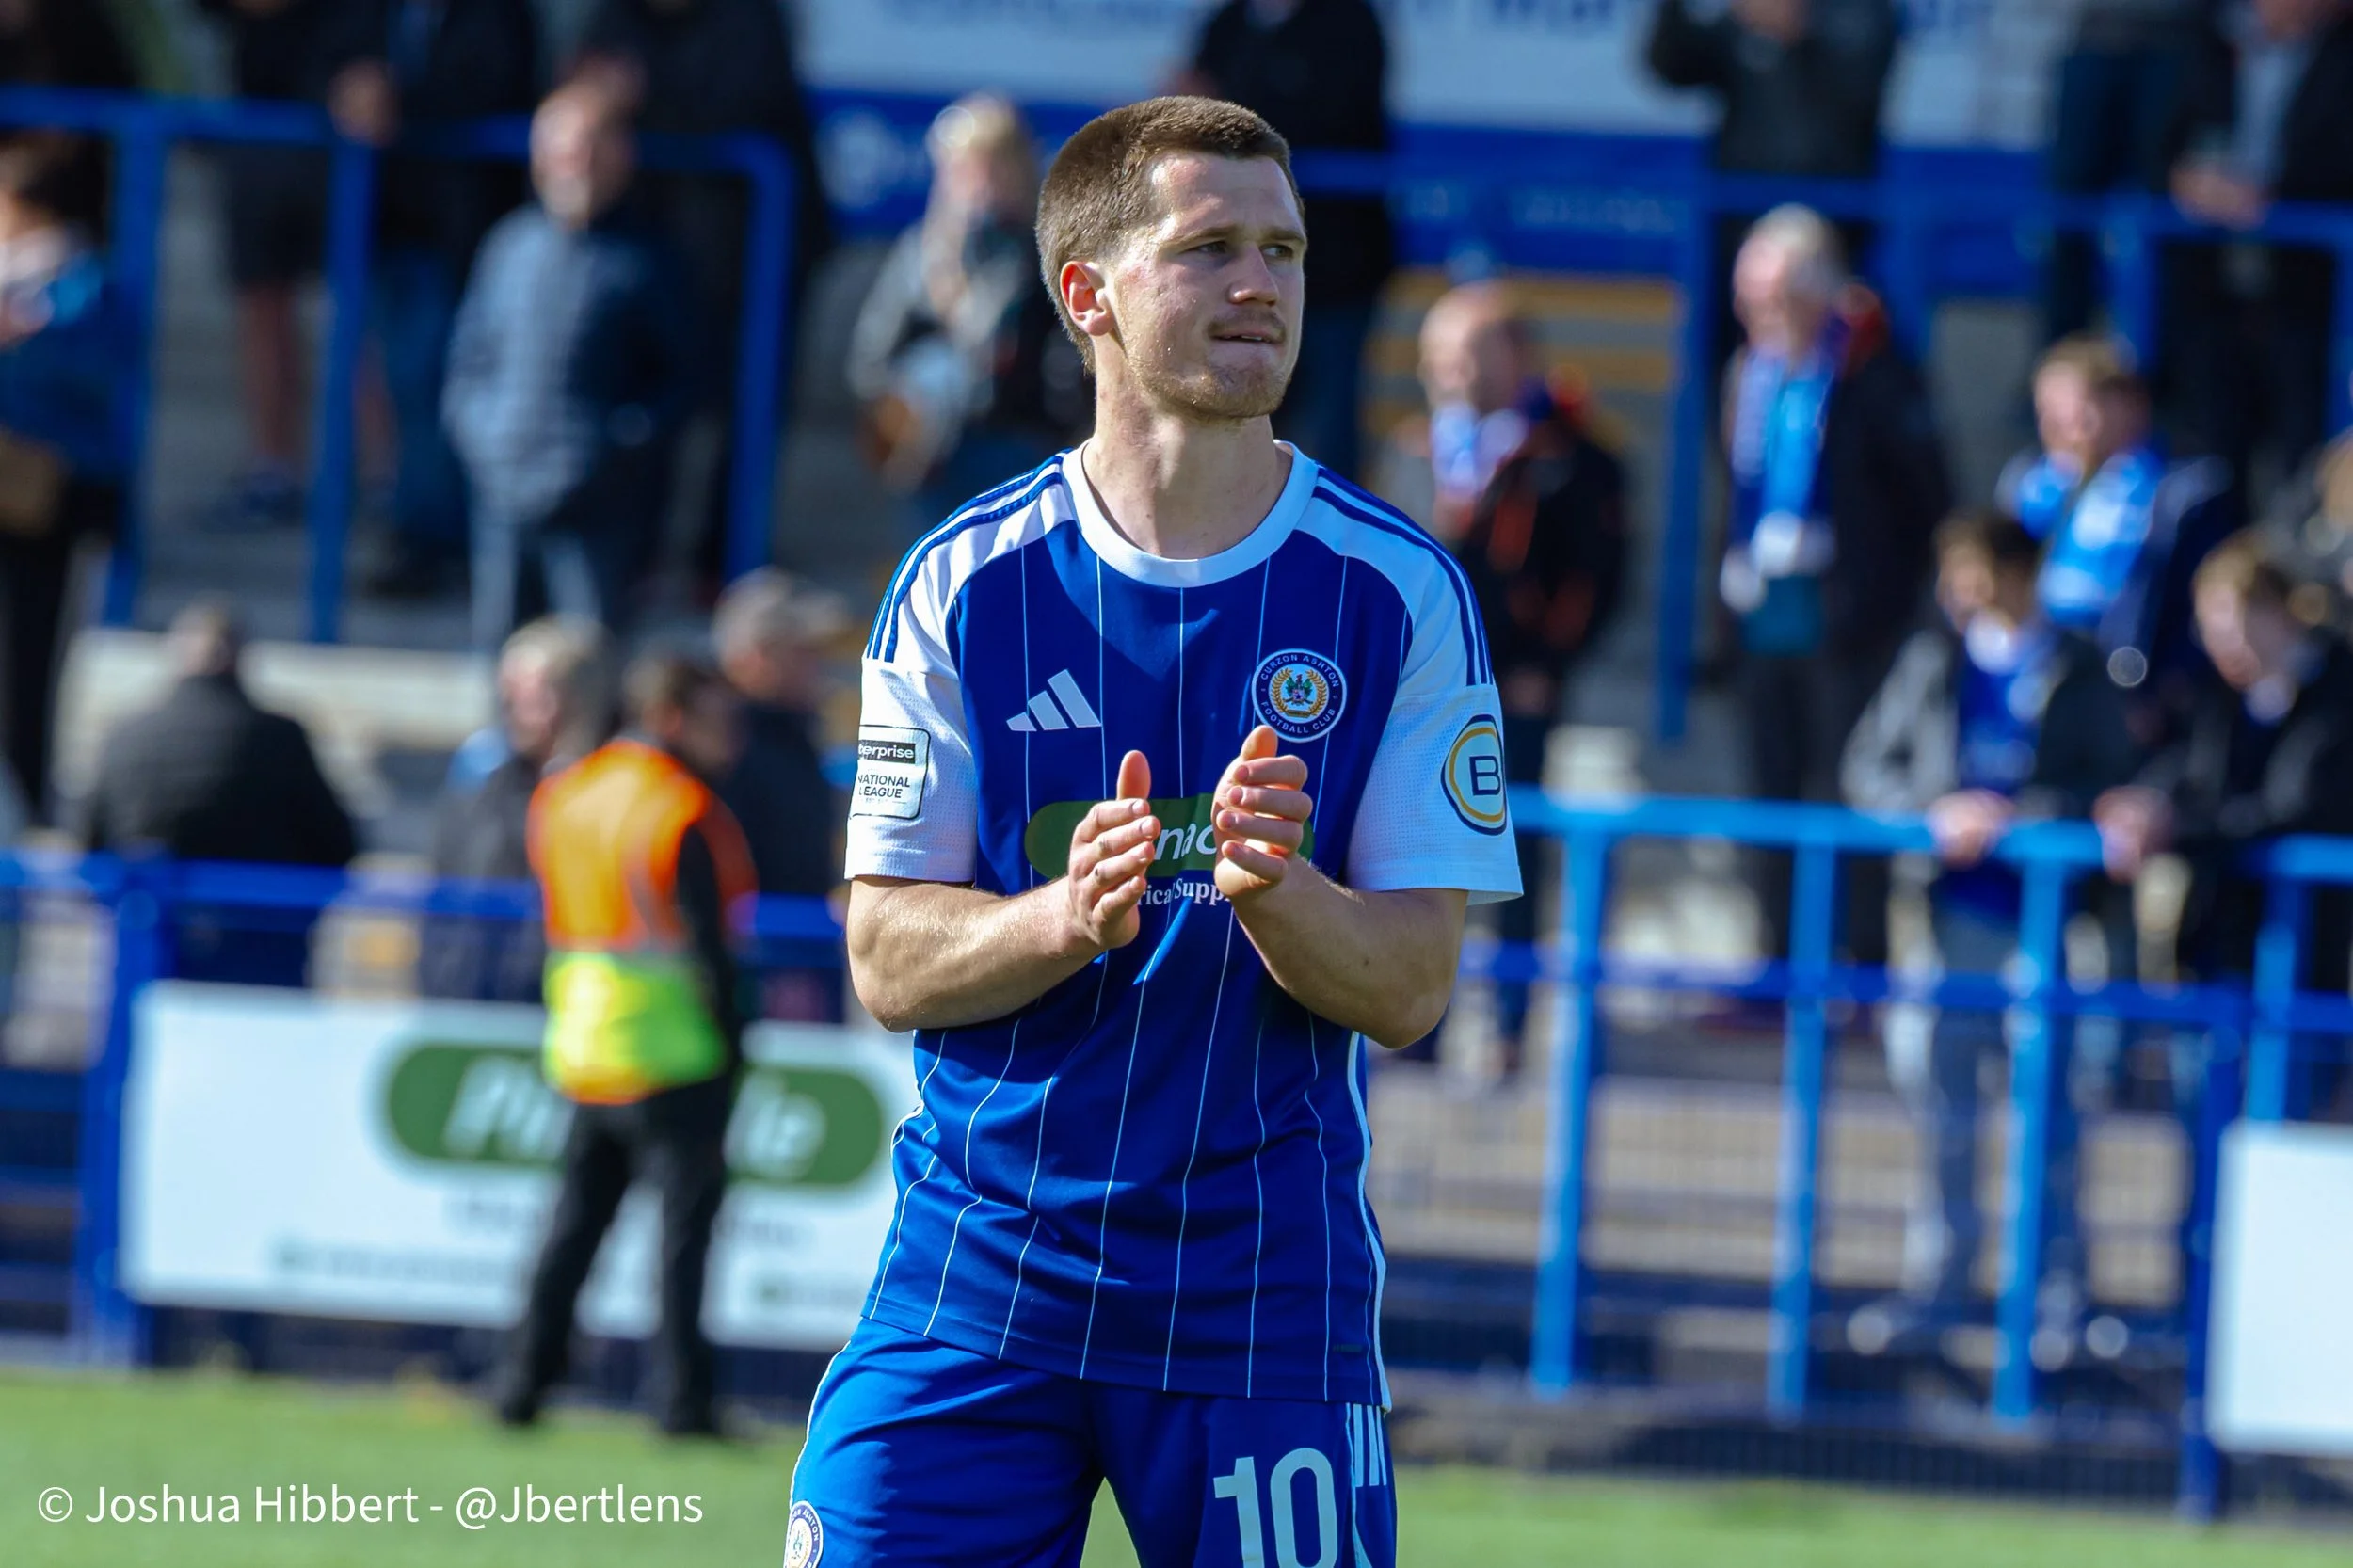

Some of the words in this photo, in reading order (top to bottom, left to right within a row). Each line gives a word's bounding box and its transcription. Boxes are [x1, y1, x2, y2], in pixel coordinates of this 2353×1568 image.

[1261, 654, 1298, 680] CURZON
[1303, 655, 1339, 688] ASHTON
[1261, 701, 1309, 734] FOOTBALL
[1312, 708, 1336, 730] CLUB
[858, 744, 915, 759] terprise
[1469, 755, 1501, 796] B
[1213, 1448, 1338, 1568] 10
